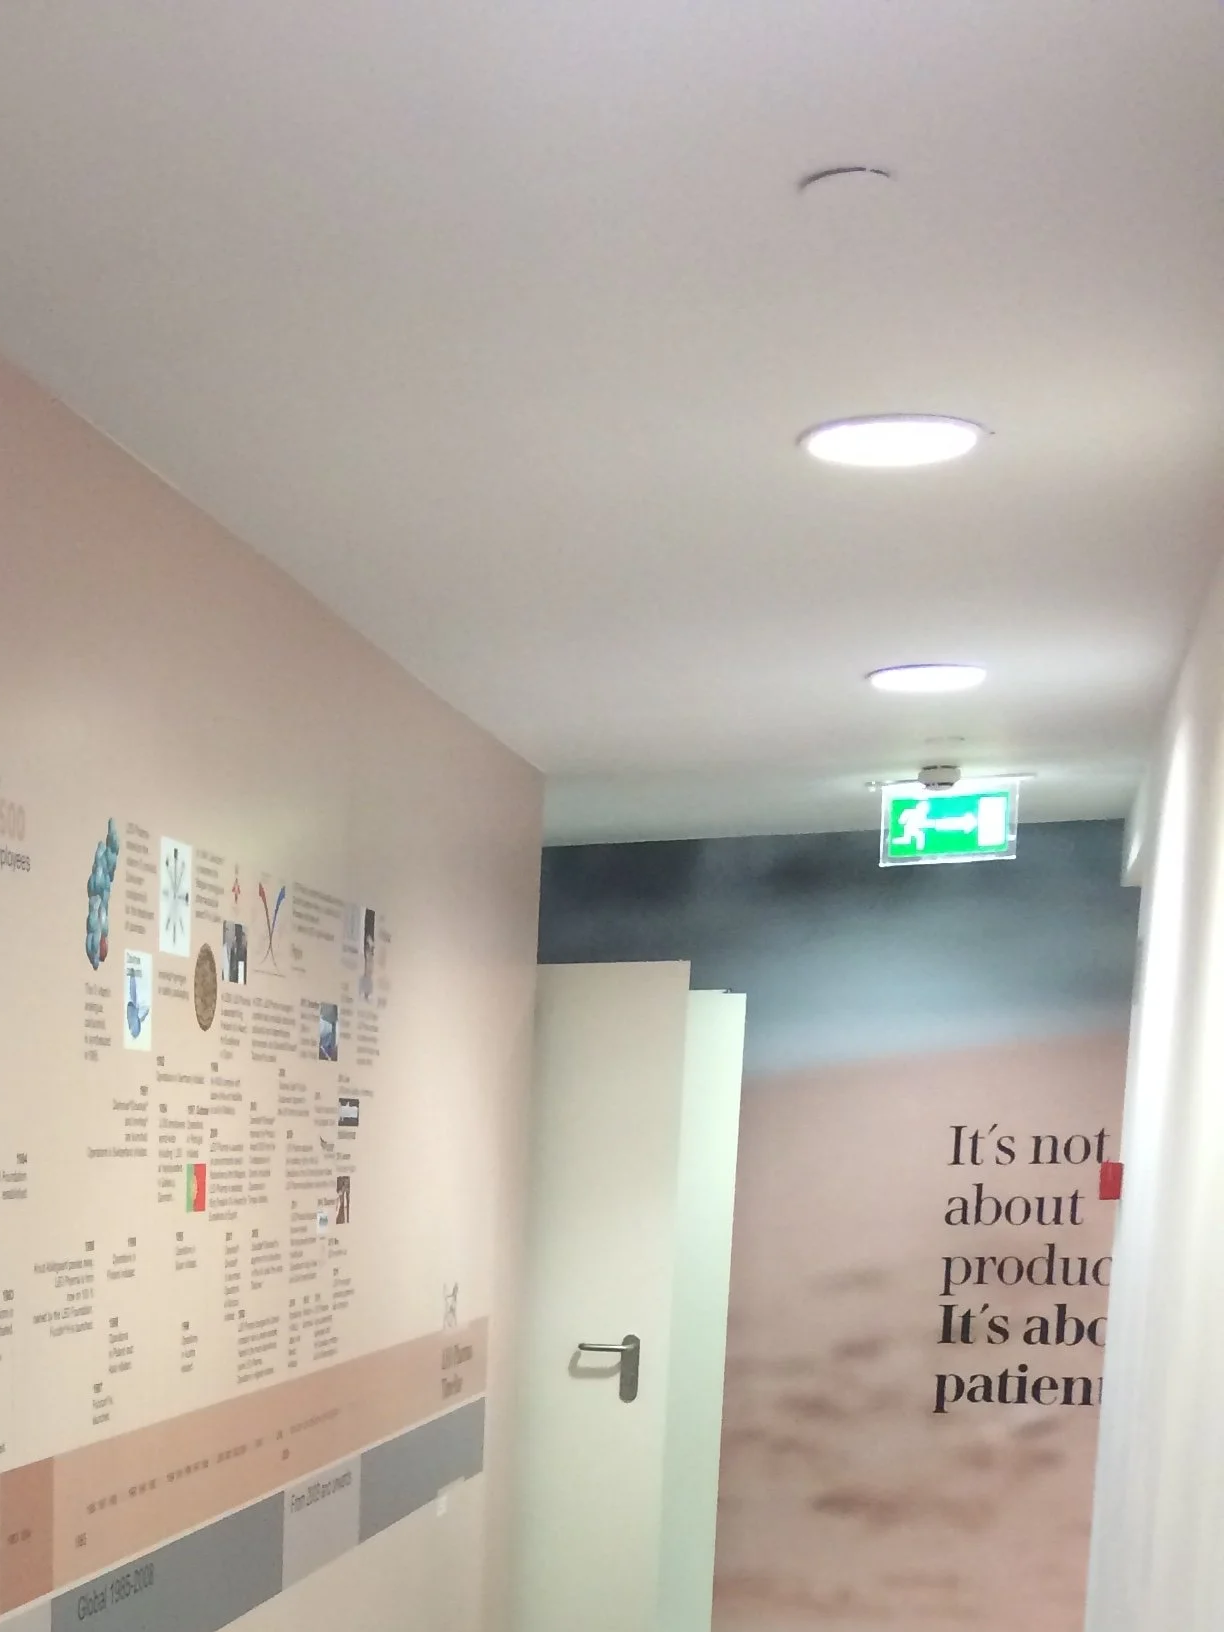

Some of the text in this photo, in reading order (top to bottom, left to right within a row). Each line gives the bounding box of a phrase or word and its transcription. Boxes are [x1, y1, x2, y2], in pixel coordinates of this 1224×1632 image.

[1028, 1128, 1110, 1164] not
[944, 1183, 1085, 1226] about
[932, 1364, 1103, 1413] patien
